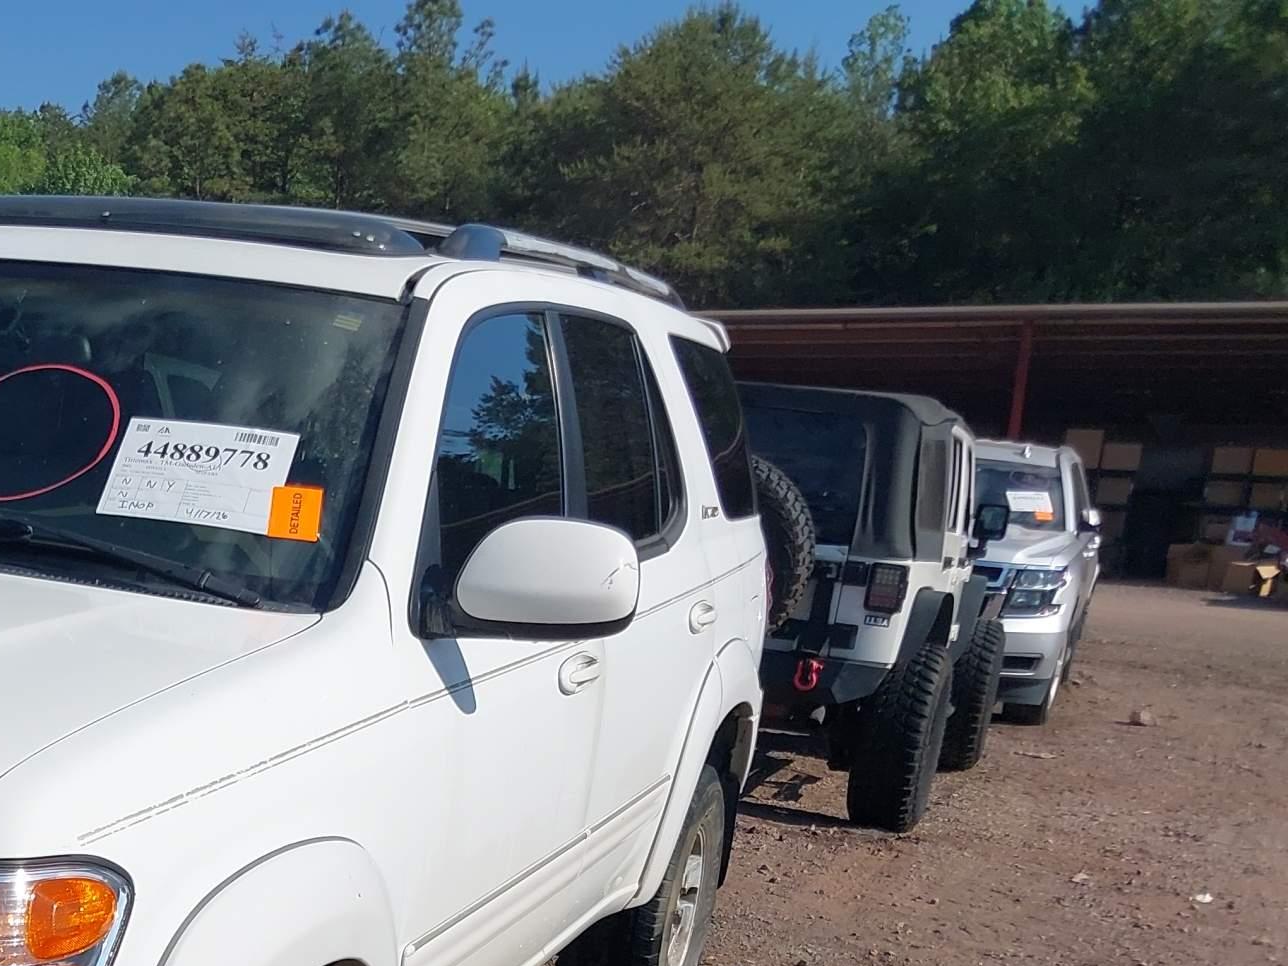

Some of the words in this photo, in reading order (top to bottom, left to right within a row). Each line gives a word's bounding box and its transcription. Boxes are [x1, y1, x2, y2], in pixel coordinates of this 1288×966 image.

[137, 440, 271, 470] 44889778
[146, 480, 157, 489] N
[167, 481, 176, 493] Y
[118, 500, 154, 512] INOP
[185, 508, 229, 520] 4/17/26
[289, 493, 303, 534] DETAILED
